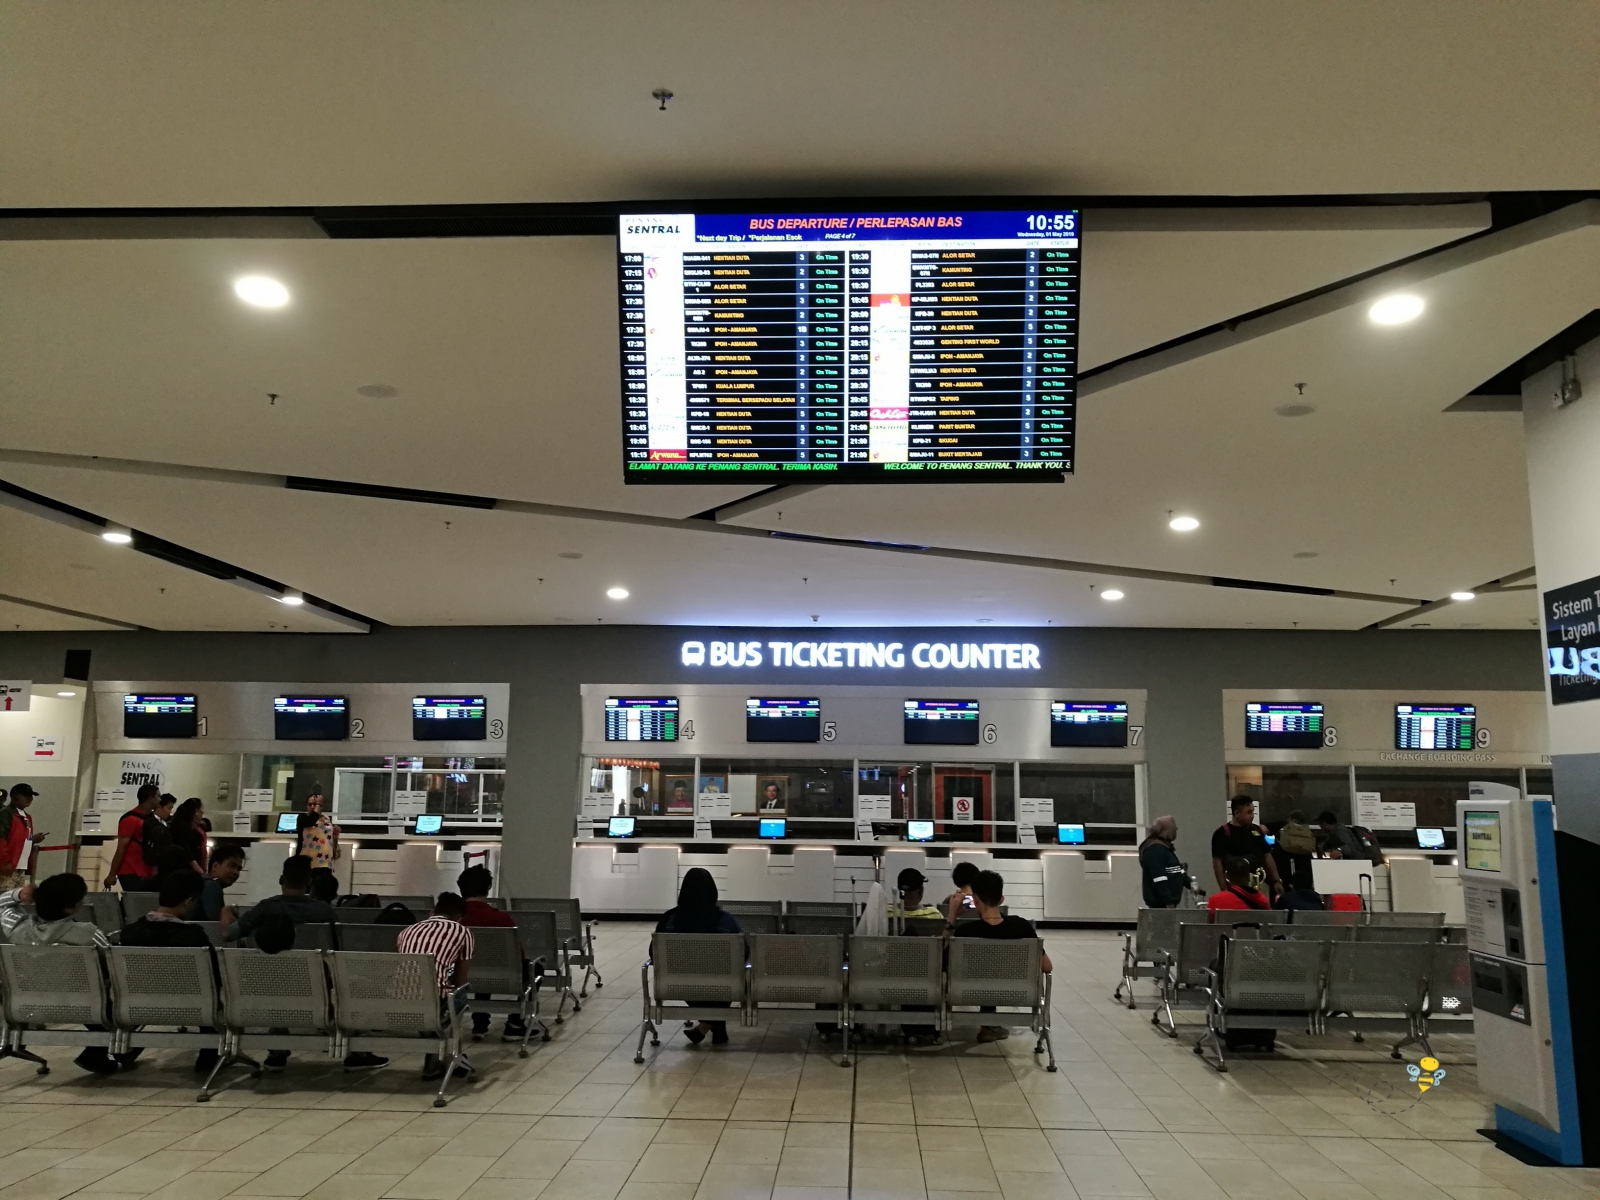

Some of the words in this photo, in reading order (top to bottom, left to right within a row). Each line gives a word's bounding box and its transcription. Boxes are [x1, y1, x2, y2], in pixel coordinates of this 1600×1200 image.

[627, 225, 680, 234] SENTRAL
[750, 218, 774, 230] BUS
[776, 218, 848, 229] DEPARTURE
[849, 218, 856, 228] /
[856, 217, 934, 228] PERLEPASAN
[937, 217, 962, 227] BAS
[1026, 214, 1074, 230] 10:55
[1552, 597, 1592, 620] Sistem
[1561, 621, 1596, 644] Layan
[710, 641, 762, 666] BUS
[768, 642, 905, 668] TICKETING
[912, 643, 1041, 669] COUNTER
[198, 716, 208, 736] 1
[350, 718, 364, 738] 2
[490, 719, 504, 739] 3
[680, 720, 695, 739] 4
[823, 722, 837, 741] 5
[982, 724, 997, 744] 6
[1129, 726, 1143, 746] 7
[1324, 726, 1338, 747] 8
[1476, 728, 1491, 748] 9
[122, 760, 152, 770] PENANG
[1380, 753, 1425, 761] EXCHANGE
[1427, 753, 1472, 762] BOARDING
[120, 772, 160, 786] SENTRAL
